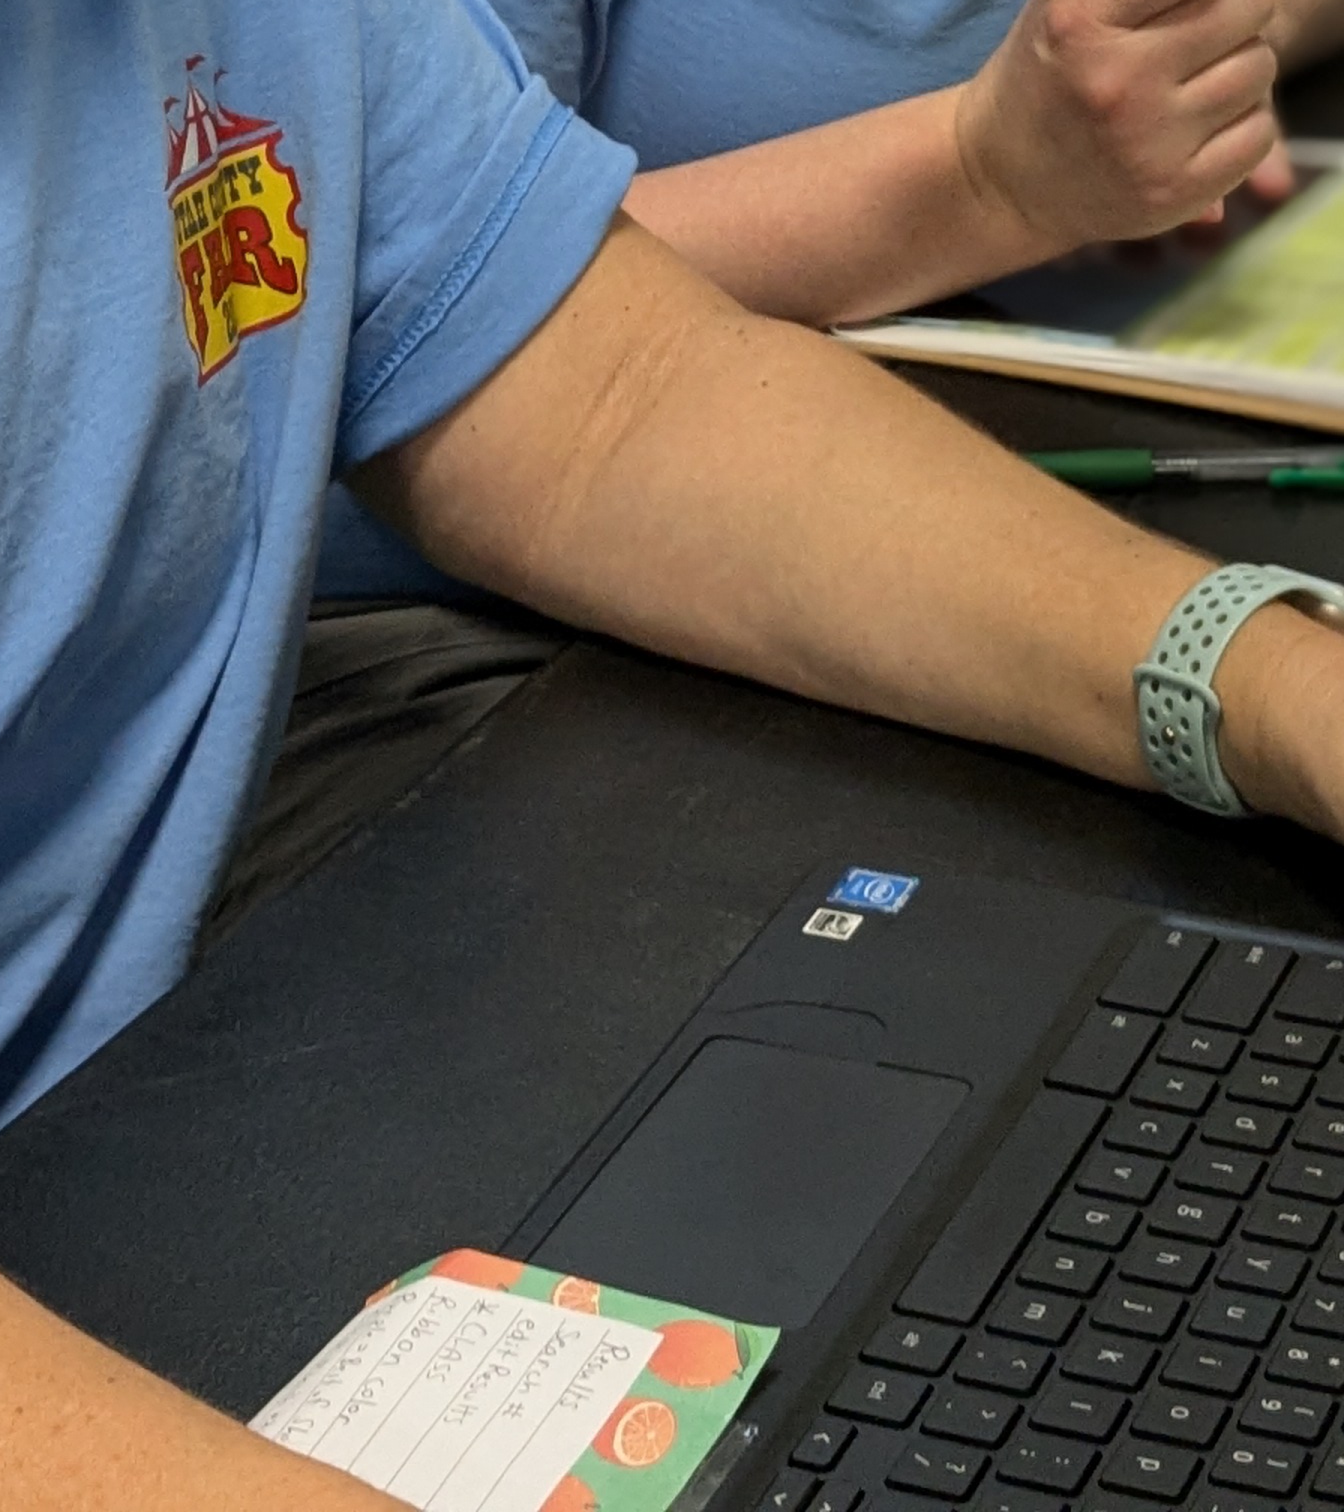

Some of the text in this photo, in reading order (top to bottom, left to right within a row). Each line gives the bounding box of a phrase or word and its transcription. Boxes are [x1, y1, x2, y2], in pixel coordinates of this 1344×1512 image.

[381, 1291, 457, 1366] Ribbon
[517, 1329, 581, 1394] Search
[443, 1318, 535, 1424] edit Results
[558, 1339, 631, 1410] Results
